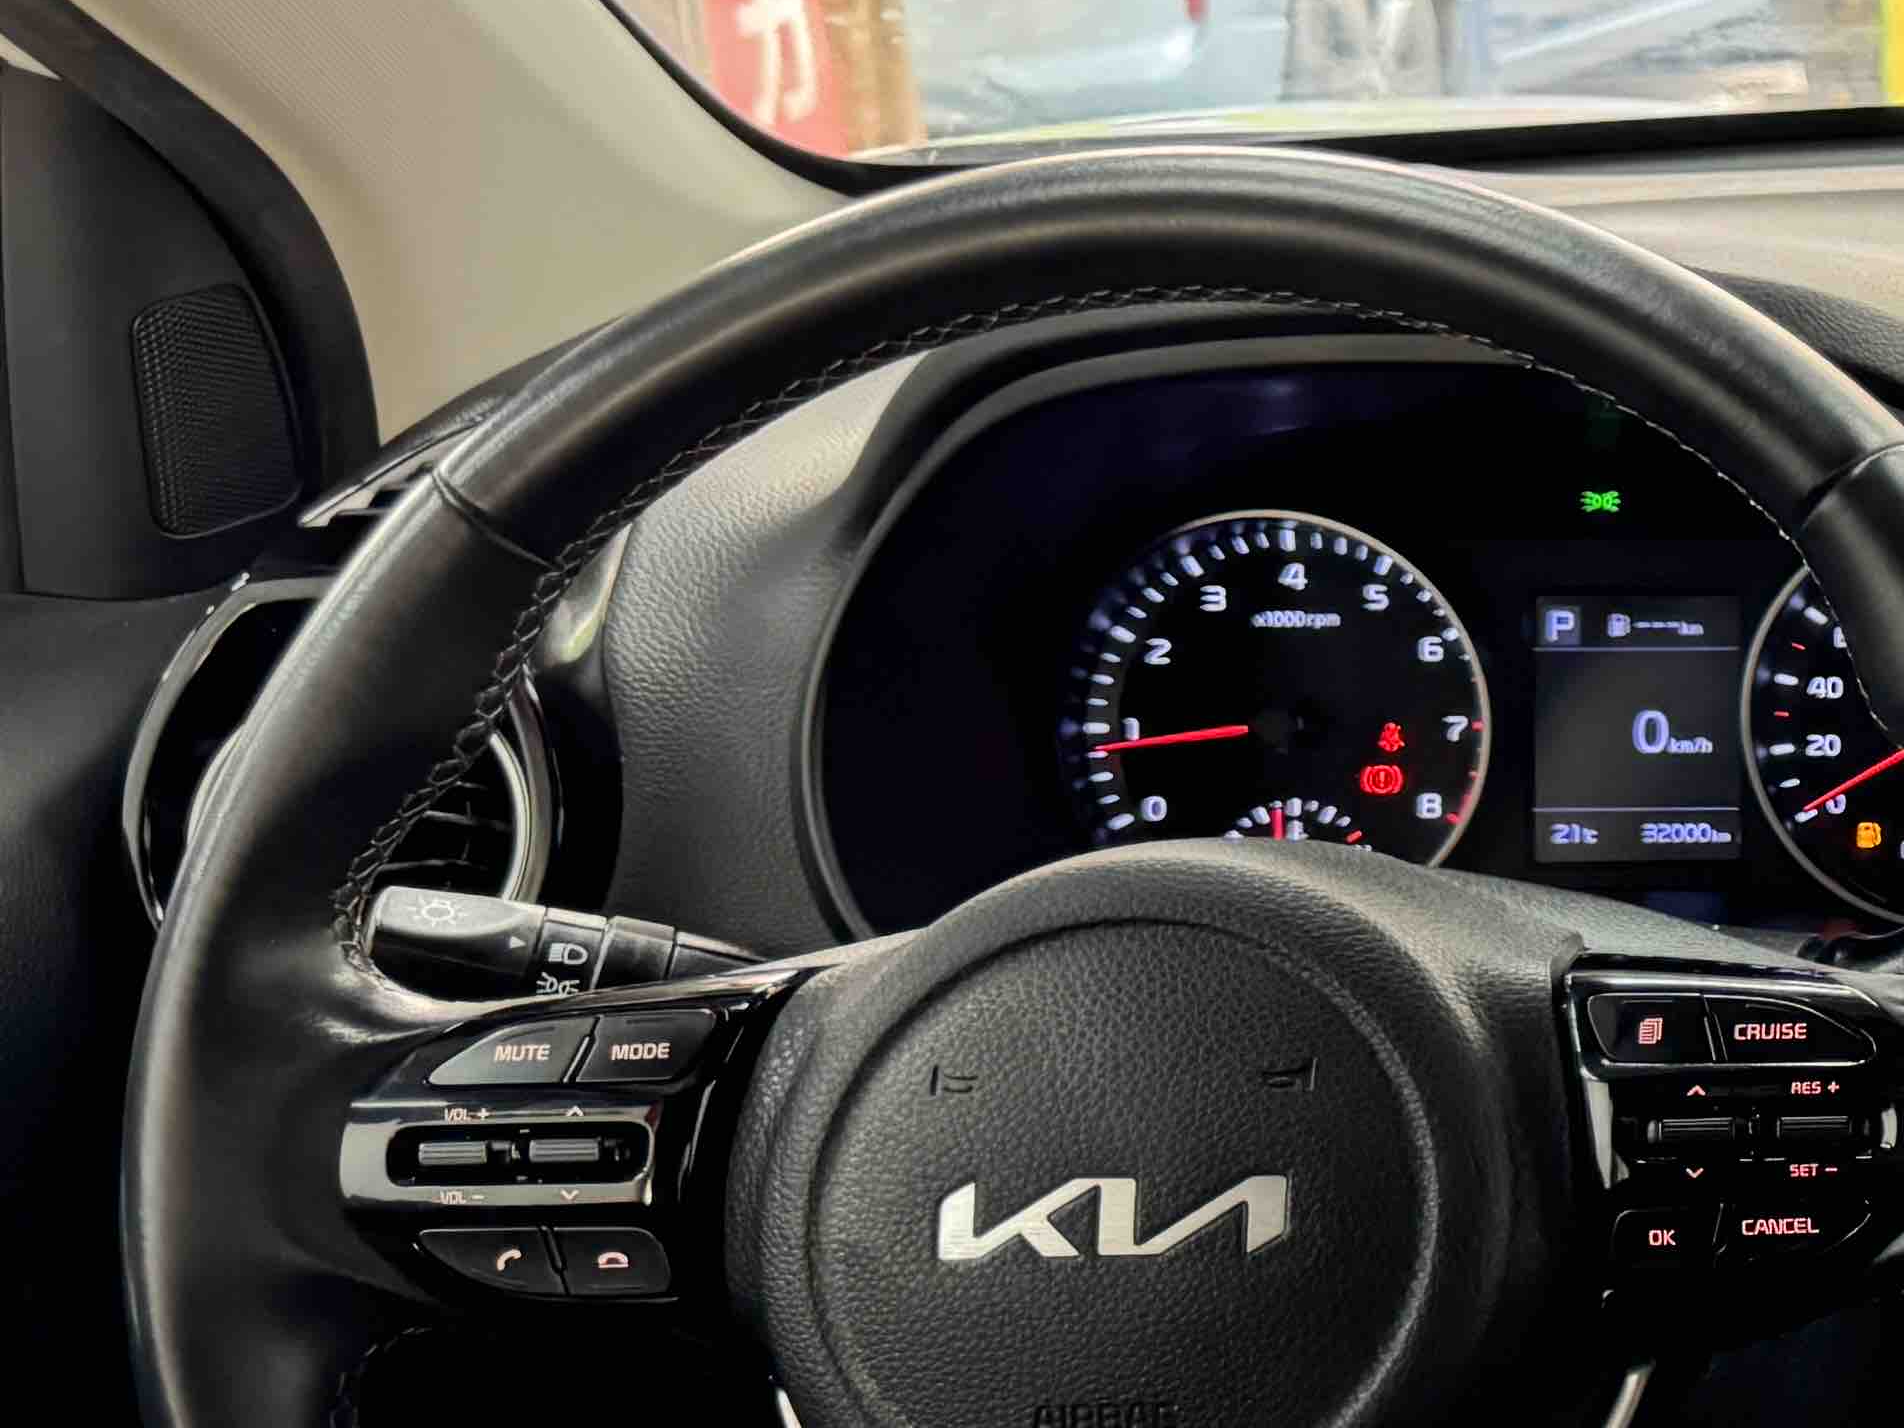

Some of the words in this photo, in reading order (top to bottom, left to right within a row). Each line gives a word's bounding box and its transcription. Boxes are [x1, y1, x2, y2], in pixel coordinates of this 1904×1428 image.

[1277, 561, 1309, 591] 4
[1199, 584, 1228, 612] 3
[1360, 583, 1390, 611] 5
[1545, 609, 1575, 643] P
[1143, 637, 1172, 666] 2
[1416, 635, 1445, 663] 6
[1805, 676, 1845, 700] 40
[1122, 716, 1141, 741] 1
[1441, 714, 1469, 743] 7
[1803, 733, 1843, 759] 20
[1139, 795, 1168, 822] 0
[1414, 791, 1443, 820] 8
[1733, 1022, 1808, 1041] CRUISE
[494, 1043, 552, 1063] MUTE
[610, 1042, 672, 1062] MODE
[937, 1174, 1291, 1262] KIA
[1740, 1217, 1821, 1237] CANCEL
[1648, 1228, 1678, 1247] OK
